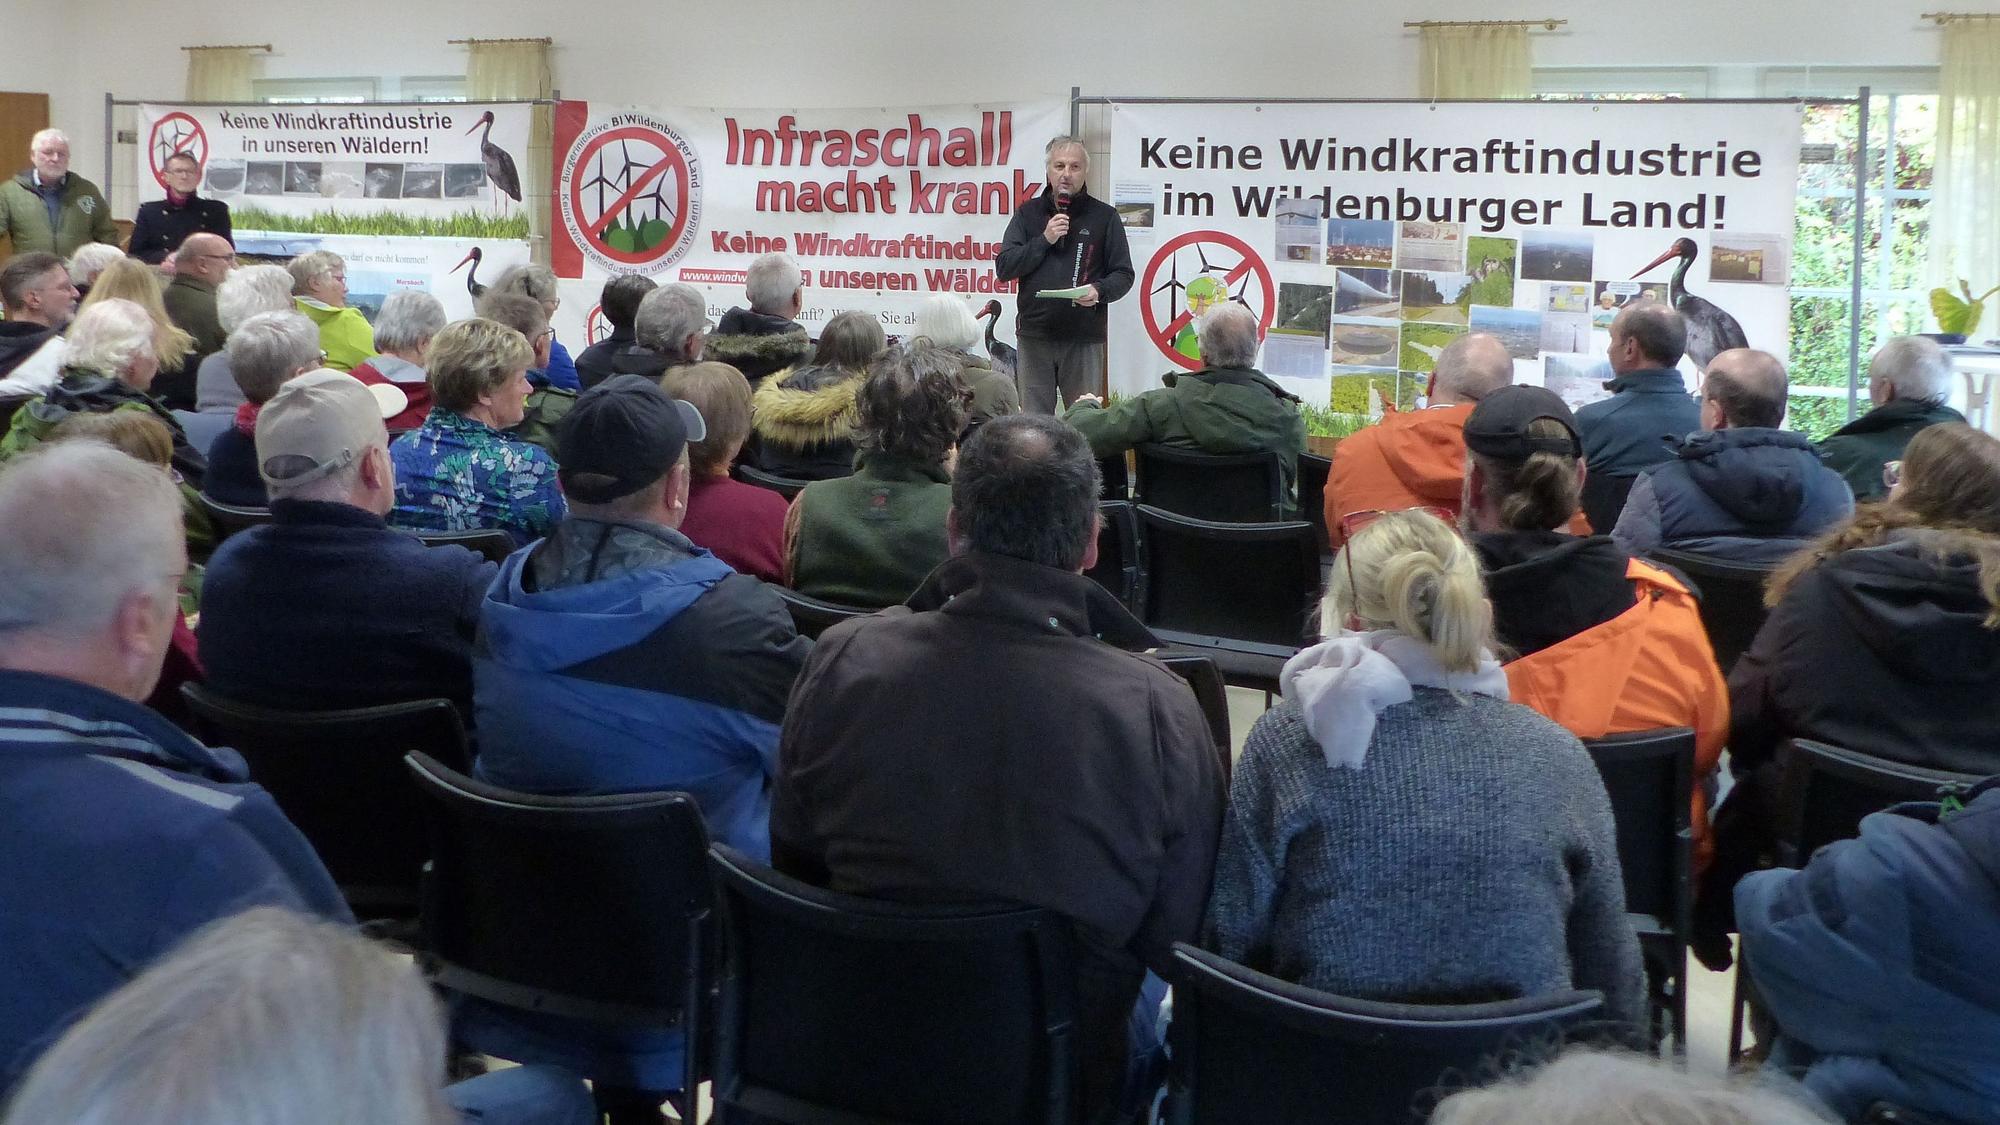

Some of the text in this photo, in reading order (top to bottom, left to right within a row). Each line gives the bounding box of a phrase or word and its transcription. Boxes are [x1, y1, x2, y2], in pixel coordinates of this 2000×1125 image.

[220, 112, 453, 130] Keine Windkraftindustrie
[242, 136, 429, 154] in unseren Wäldern!
[611, 115, 623, 127] BI
[625, 114, 693, 157] Wildenburger
[688, 158, 700, 188] Land
[724, 111, 1013, 167] Infraschall
[1139, 137, 1762, 178] Keine Windkraftindustrie
[756, 169, 1043, 215] macht krank
[1163, 183, 1214, 216] im
[1582, 192, 1726, 230] Land!
[562, 193, 572, 223] Keine
[570, 225, 637, 275] Windkraftindustrie
[640, 267, 649, 275] in
[650, 246, 684, 272] unseren
[711, 230, 1003, 260] Keine Windkraftindus
[682, 272, 748, 283] www.windw
[820, 269, 918, 291] unseren
[924, 268, 1019, 294] Wälder
[881, 311, 901, 324] Sie
